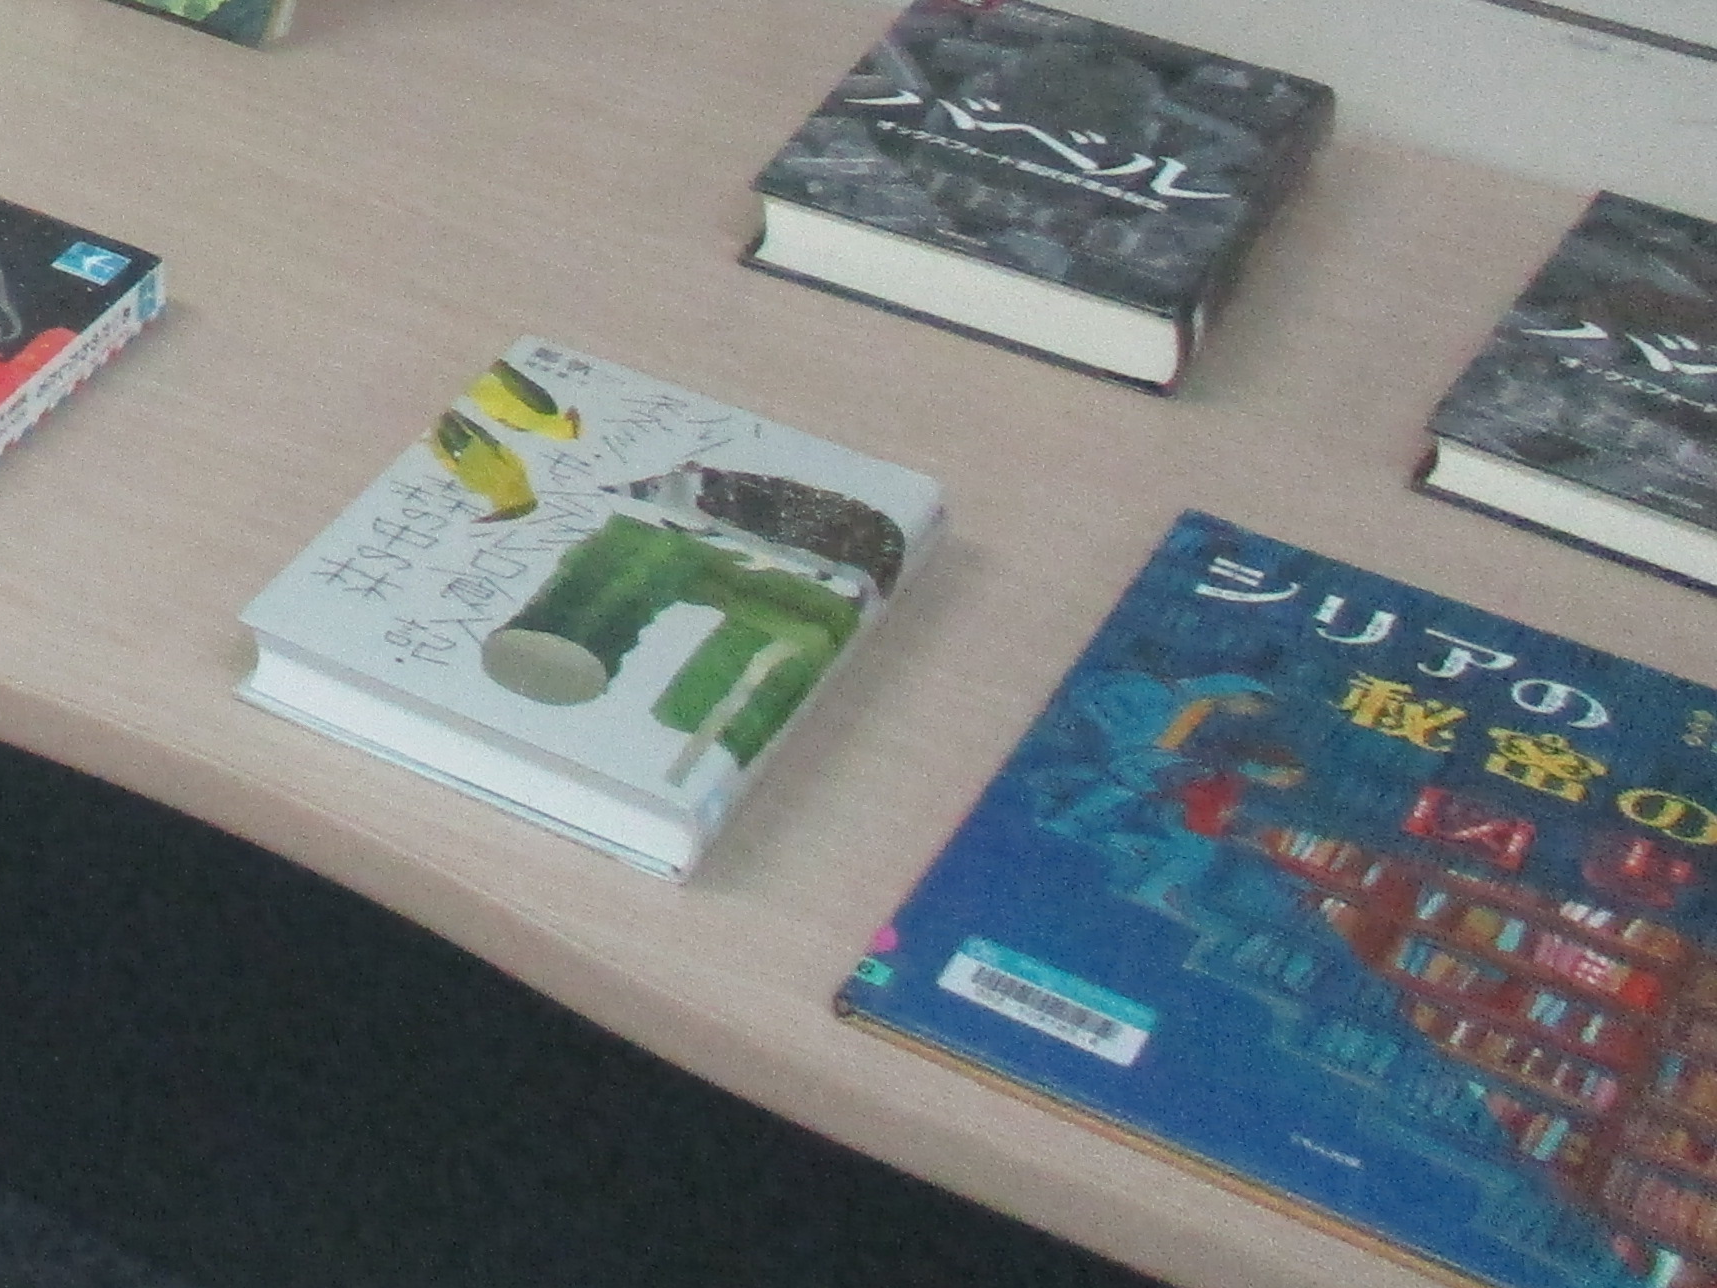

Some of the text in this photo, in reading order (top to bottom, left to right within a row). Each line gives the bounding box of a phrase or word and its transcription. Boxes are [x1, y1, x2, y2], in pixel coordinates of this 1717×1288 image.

[842, 88, 1233, 200] バベル
[1195, 555, 1612, 729] シリアの
[1327, 671, 1717, 846] 秘密の
